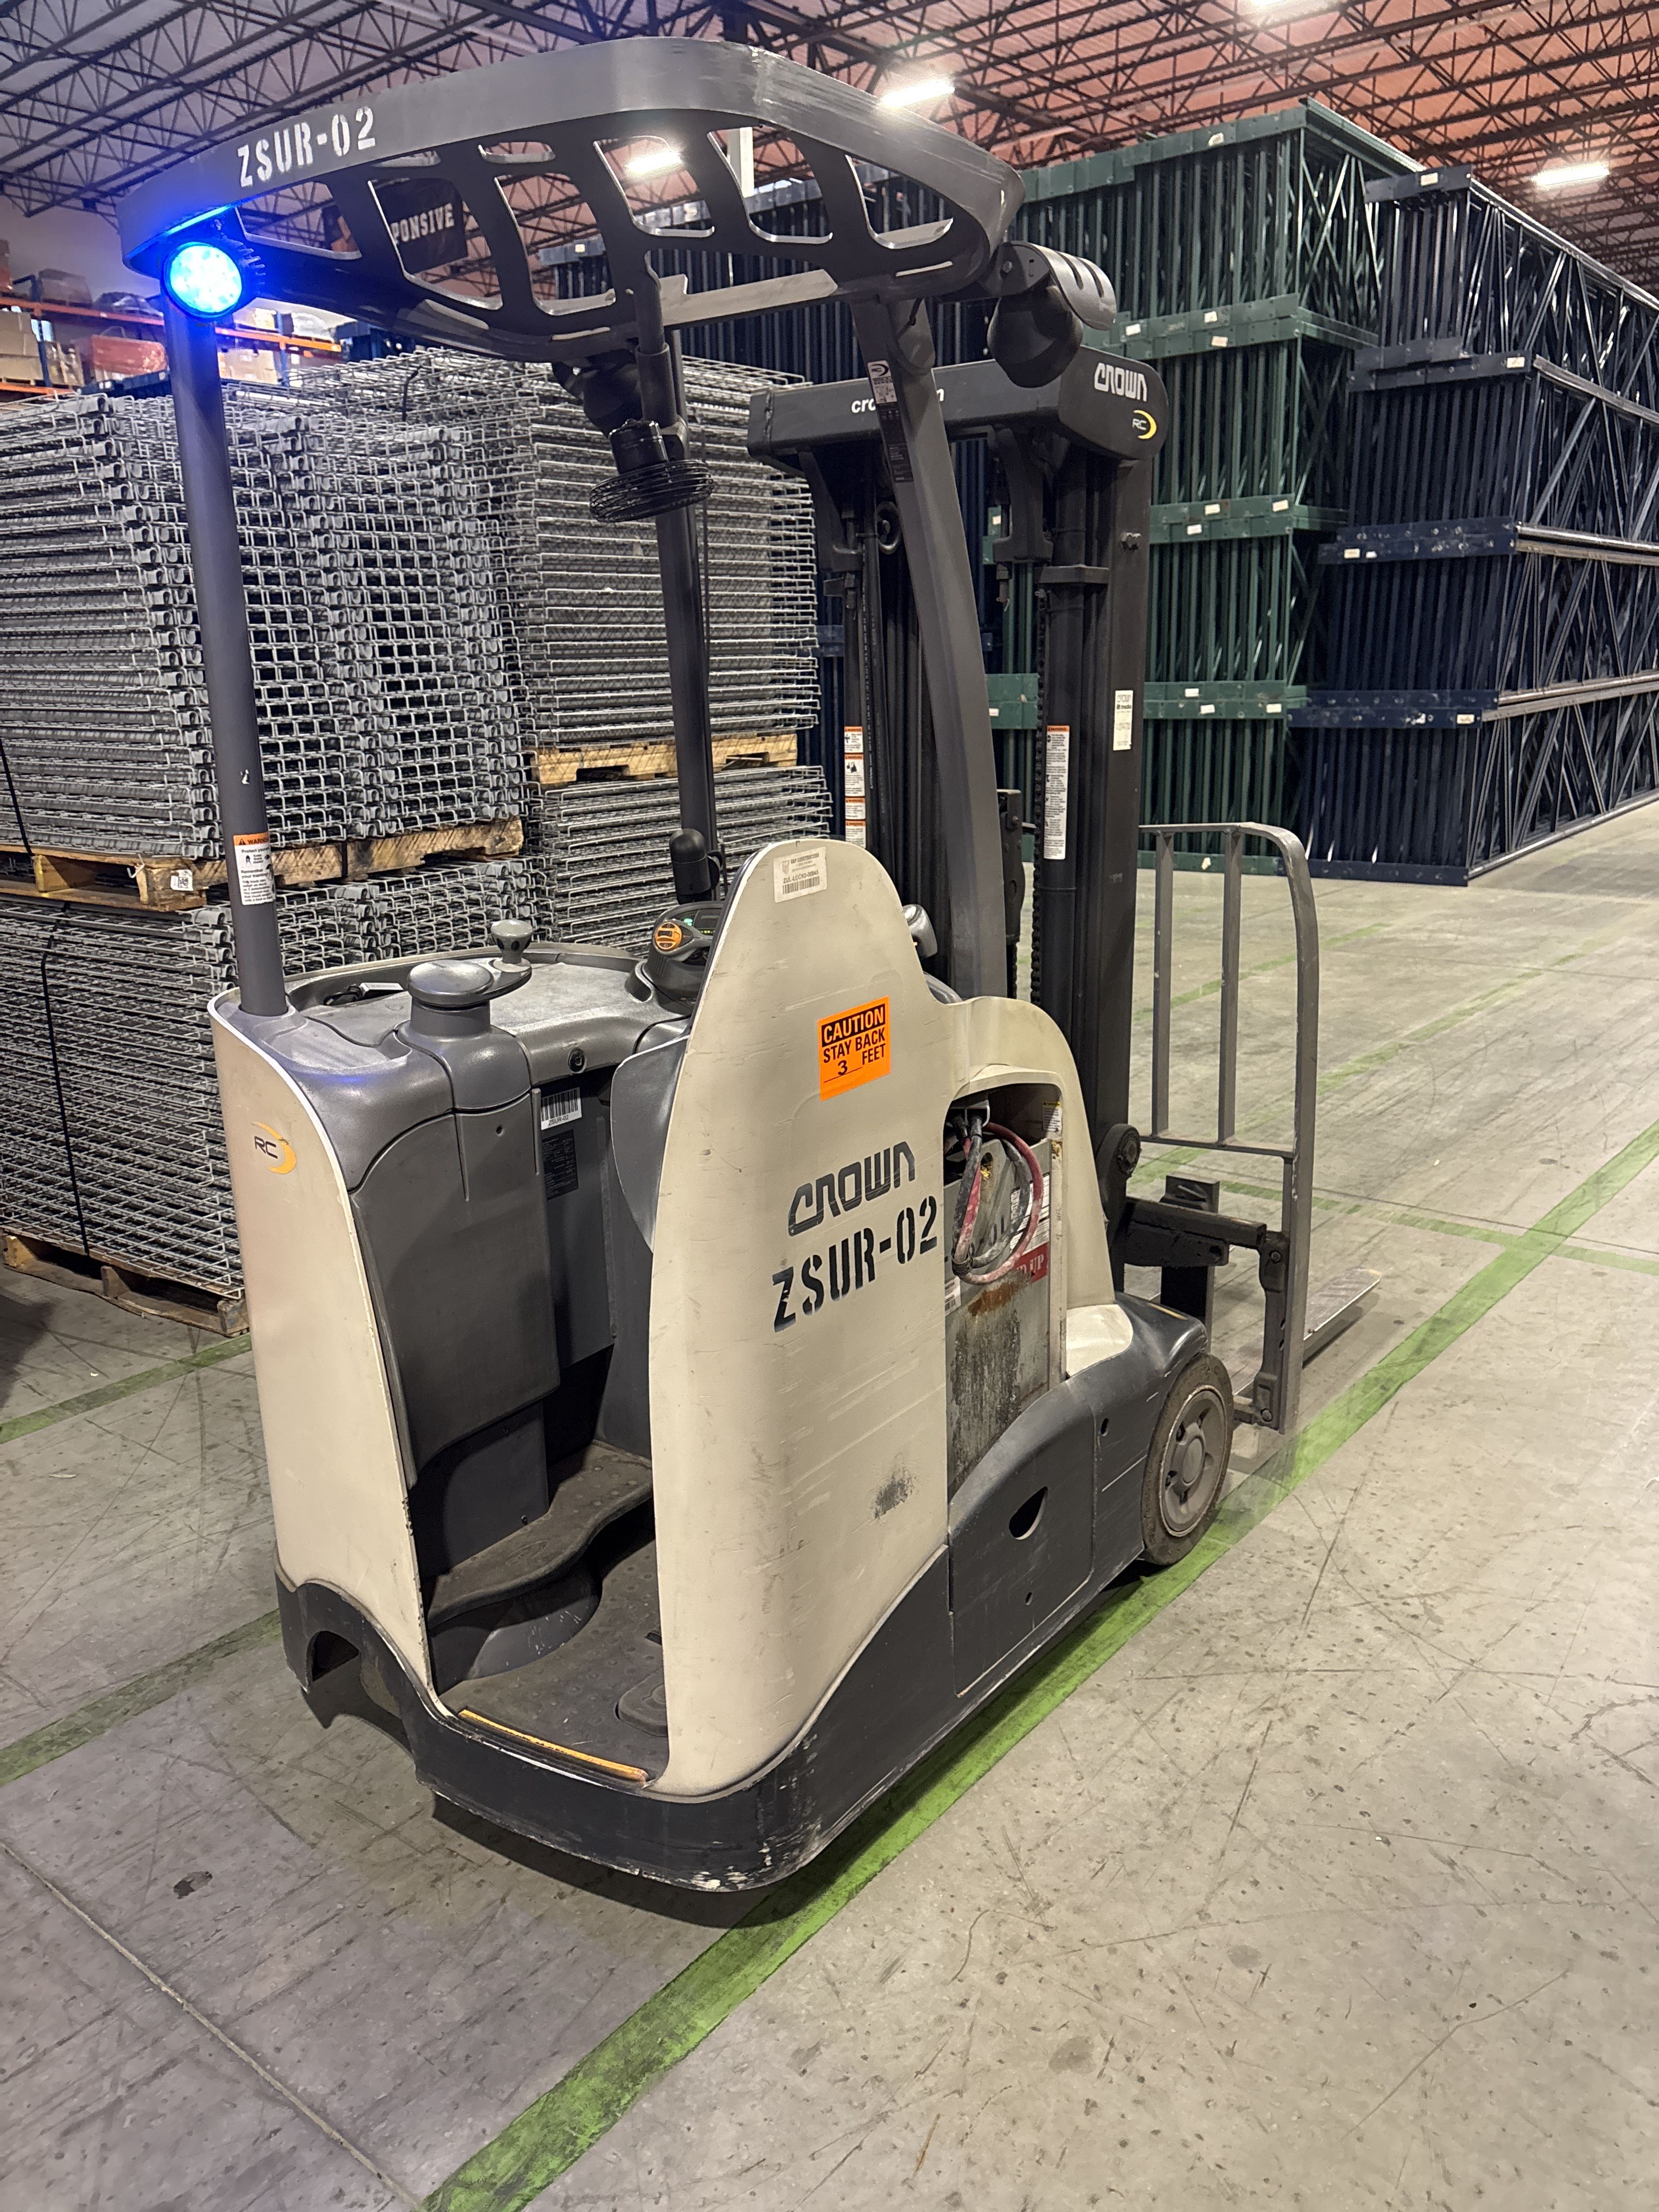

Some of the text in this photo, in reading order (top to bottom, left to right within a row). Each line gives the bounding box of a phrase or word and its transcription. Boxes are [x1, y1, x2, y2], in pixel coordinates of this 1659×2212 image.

[237, 106, 376, 187] ZSUR-02
[391, 203, 454, 245] PONSIVE
[1094, 362, 1147, 402] CROWN
[1132, 418, 1147, 431] RC
[823, 1006, 884, 1044] CAUTION
[823, 1027, 886, 1064] STAY BACK
[837, 1043, 886, 1076] 3 FEET
[548, 1115, 569, 1126] ZSUR-02
[254, 1136, 278, 1159] RC
[788, 1141, 915, 1237] CROWN
[772, 1196, 938, 1333] ZSUR-02
